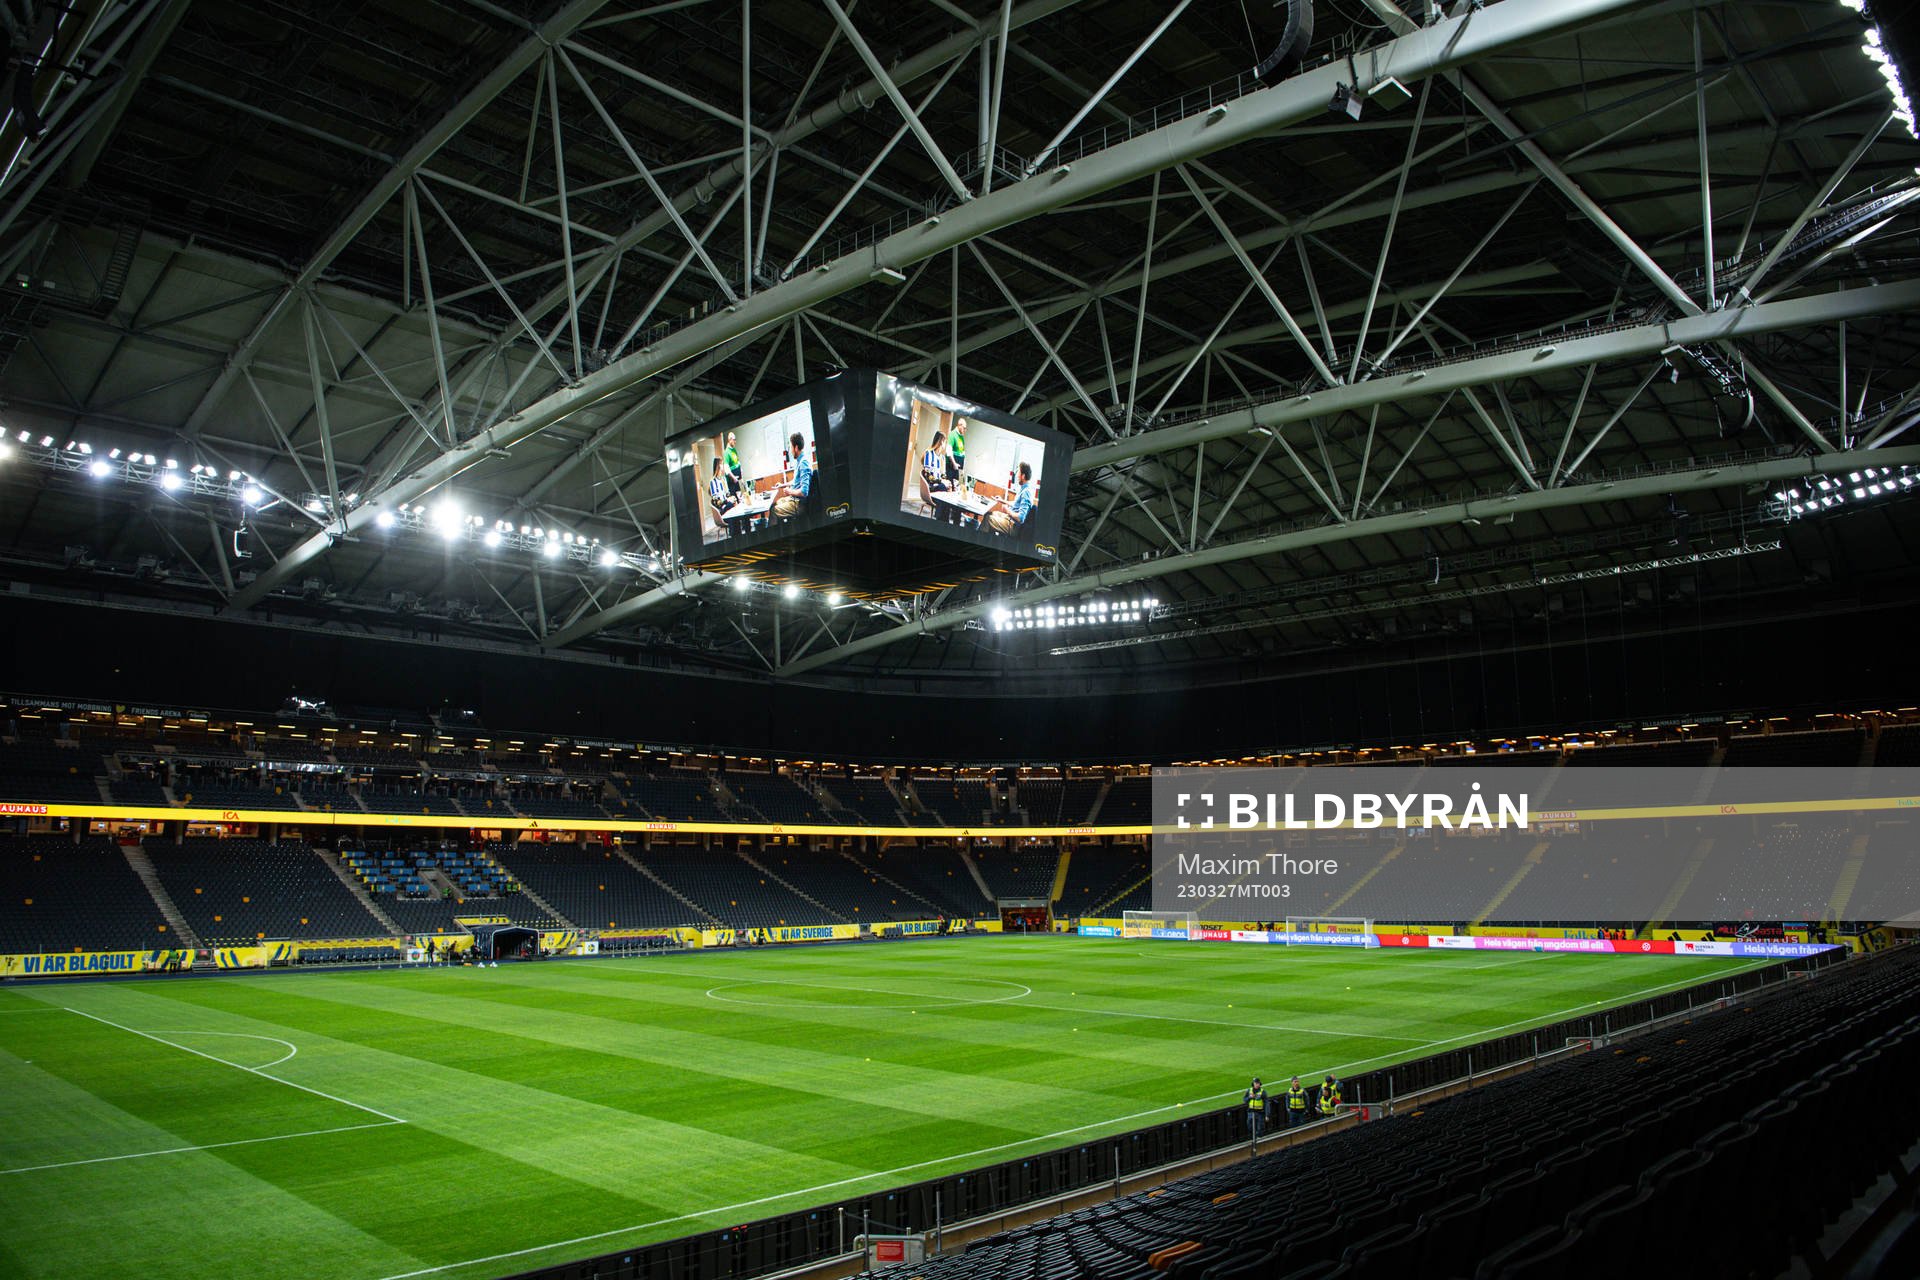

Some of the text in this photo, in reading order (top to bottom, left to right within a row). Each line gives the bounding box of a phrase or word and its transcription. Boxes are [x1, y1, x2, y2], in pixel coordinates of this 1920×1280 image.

[61, 702, 76, 710] MOT
[131, 707, 159, 716] FRIENDS
[160, 710, 182, 718] ARENA
[1721, 805, 1737, 813] ICA
[223, 811, 240, 820] ICA
[802, 927, 833, 938] SVERIGE
[1744, 944, 1766, 954] Hela
[1767, 944, 1798, 956] vägen
[1800, 944, 1819, 954] från
[24, 953, 135, 973] VI ÄR BLÅGULT
